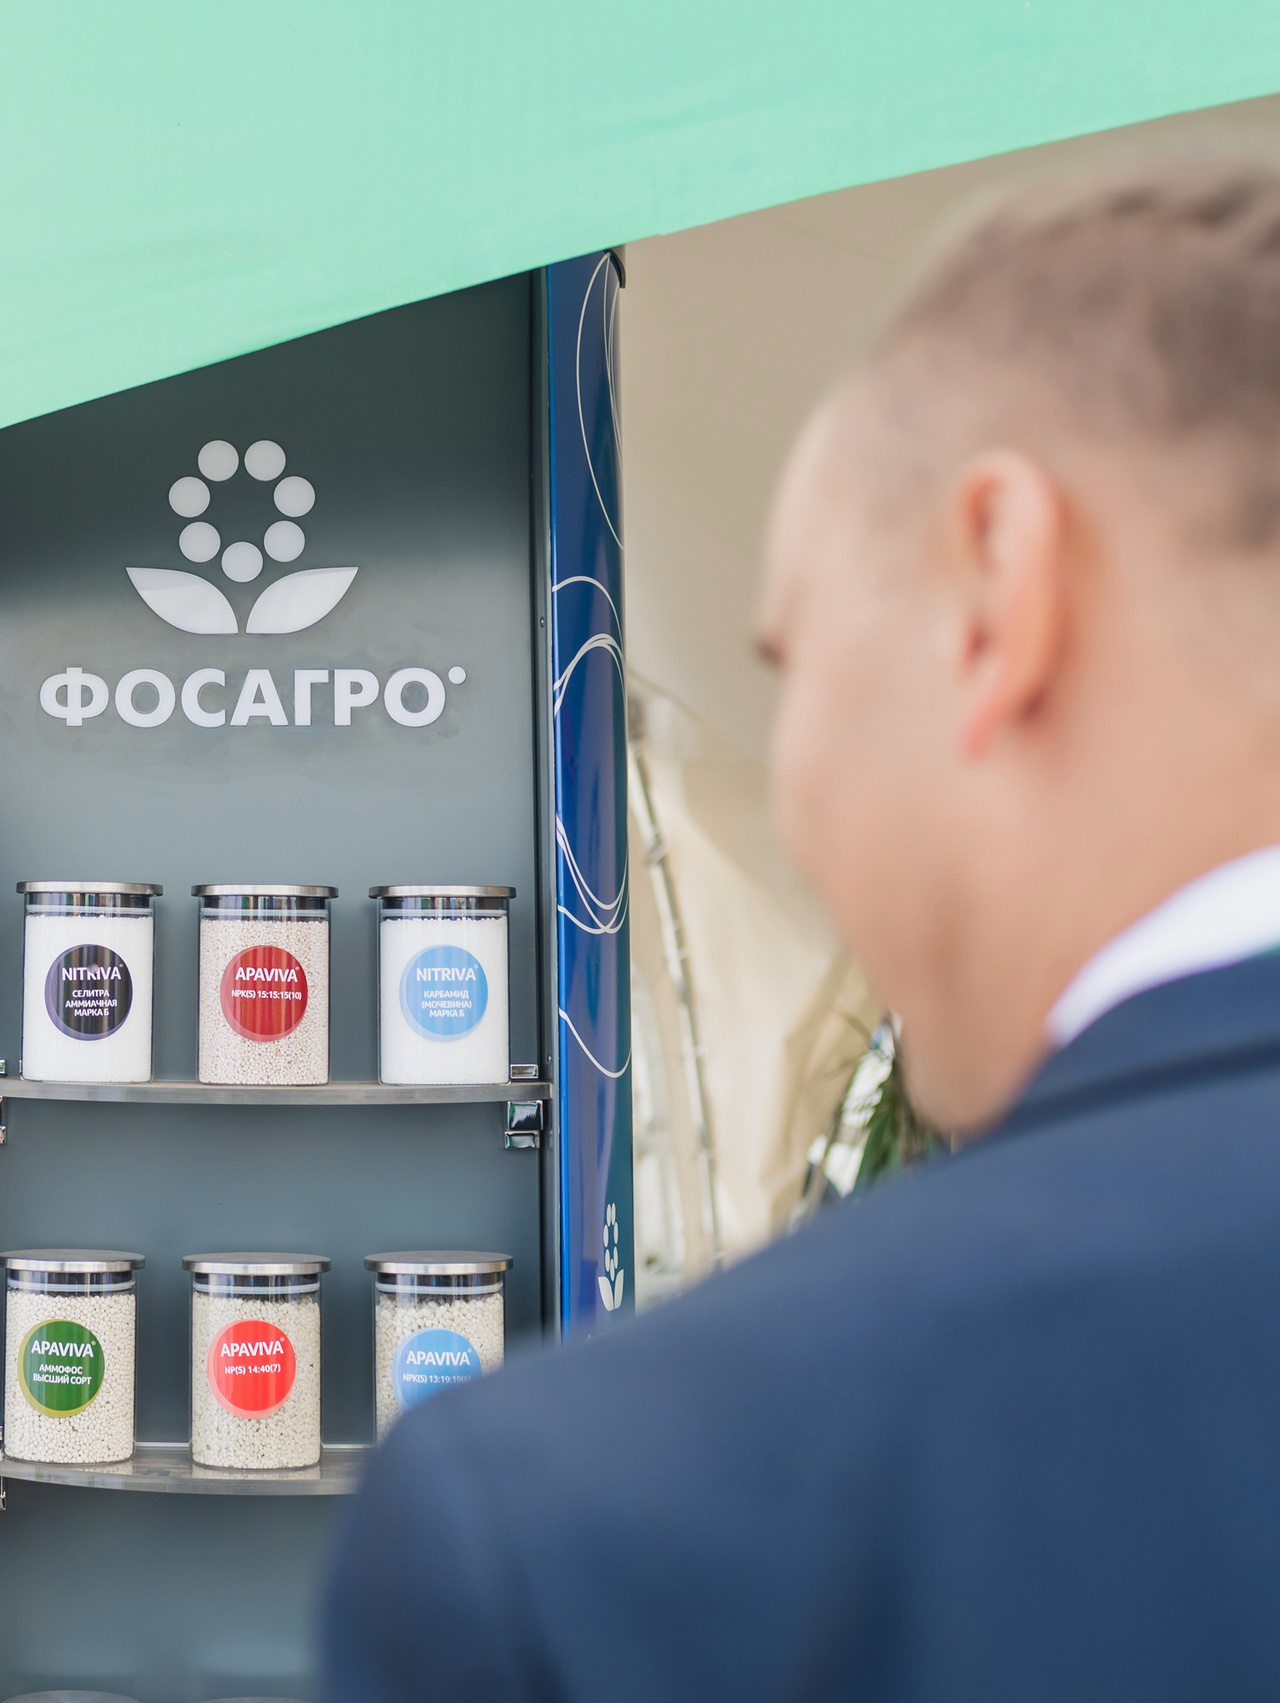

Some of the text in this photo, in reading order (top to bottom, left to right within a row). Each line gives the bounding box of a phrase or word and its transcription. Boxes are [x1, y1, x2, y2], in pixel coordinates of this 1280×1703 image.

[39, 666, 447, 728] ФОСАГРО
[235, 967, 298, 983] APAVIVA
[416, 967, 477, 982] NITRIVA
[72, 989, 110, 998] СЕЛИТРА
[231, 989, 302, 1000] NPK(S) 15:15:15(10)
[423, 990, 470, 1000] КАРБАМИД
[65, 999, 118, 1008] АММИАЧНАЯ
[421, 1000, 472, 1010] (МОЧЕВИНА)
[74, 1008, 110, 1017] МАРКА Б
[429, 1009, 465, 1018] МАРКА Б
[31, 1340, 94, 1358] APAVIVA
[220, 1340, 284, 1358] APAVIVA
[406, 1350, 471, 1366] APAVIVA
[39, 1363, 83, 1375] АММОФОС
[224, 1363, 281, 1375] NP(S) 14:40(7)
[32, 1372, 92, 1385] ВЫСШИЙ СОРТ
[402, 1373, 428, 1384] NPK(S)
